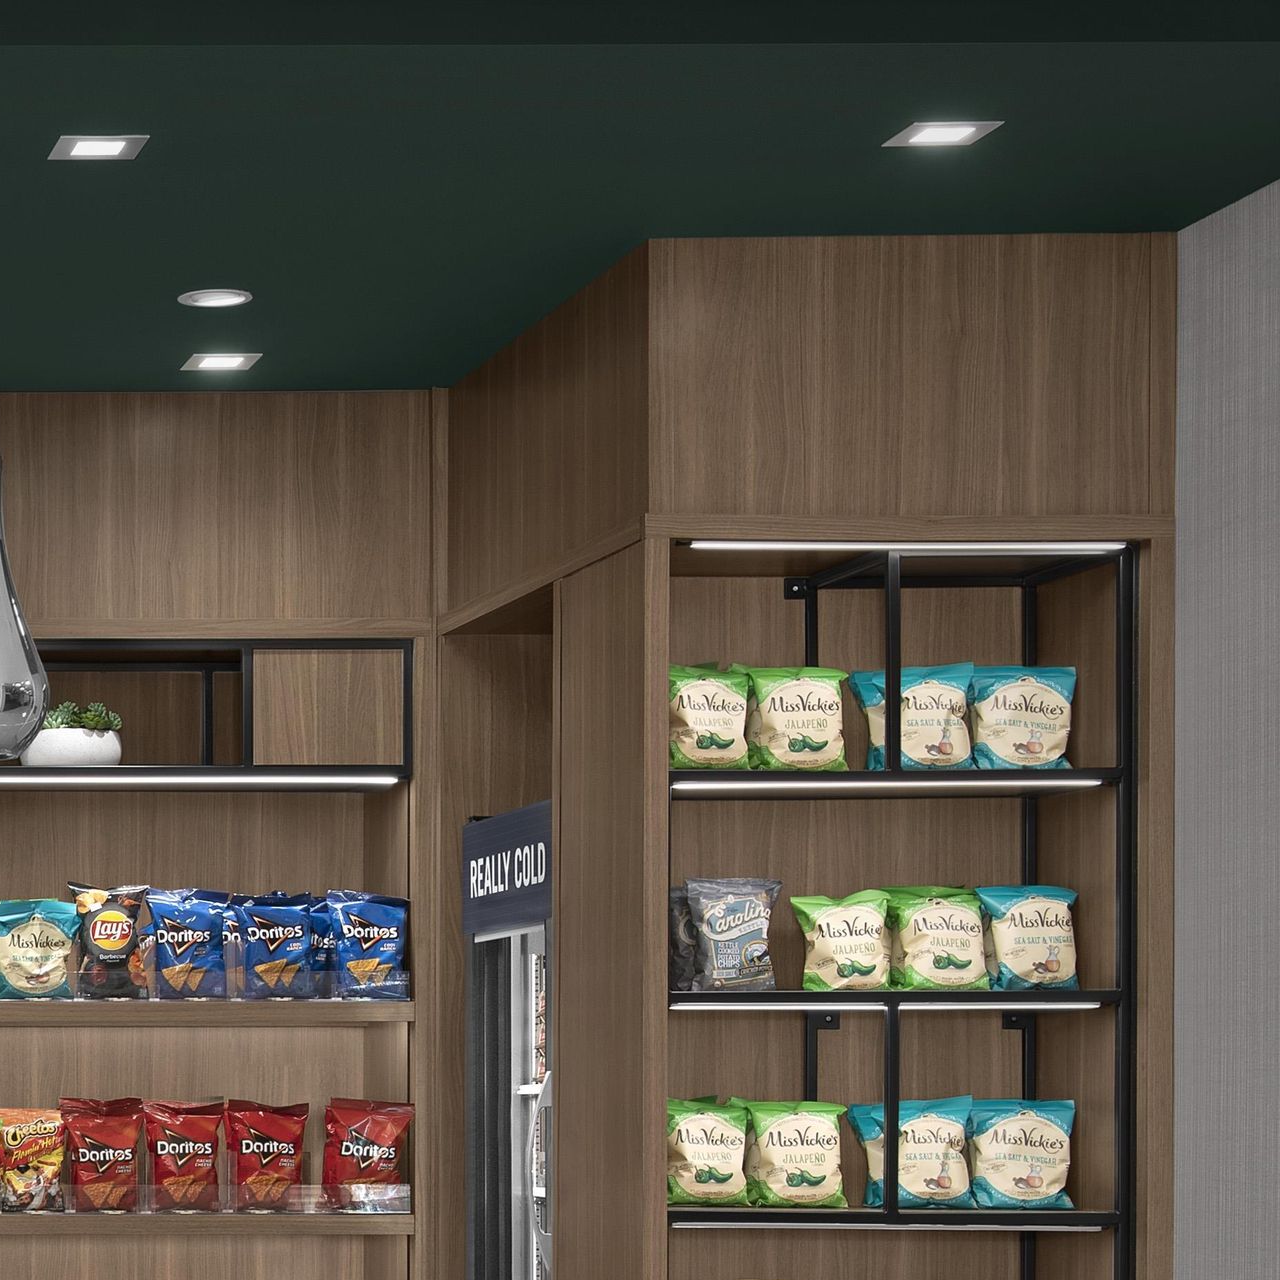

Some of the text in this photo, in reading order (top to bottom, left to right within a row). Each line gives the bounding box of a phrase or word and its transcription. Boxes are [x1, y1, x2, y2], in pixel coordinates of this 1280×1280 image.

[677, 693, 744, 716] Miss Vickie's
[768, 692, 840, 715] Miss Vickie's
[991, 693, 1064, 719] Miss Vickie's
[693, 718, 733, 727] JALAPEÑO
[785, 718, 827, 729] JALAPEÑO
[470, 842, 546, 899] REALLY COLD
[914, 914, 980, 937] Miss Vickie's
[1009, 913, 1038, 928] Miss
[94, 920, 131, 940] Lay's
[158, 929, 210, 944] Doritos
[250, 925, 303, 942] Doritos
[345, 925, 398, 940] Doritos
[816, 922, 847, 940] Miss
[9, 931, 66, 950] Miss Vickie's
[930, 937, 970, 947] JALAPEÑO
[833, 942, 875, 955] JALAPEÑO
[718, 960, 740, 968] CHIPS
[6, 1122, 57, 1148] Cheetos
[676, 1127, 744, 1150] Miss Vickie's
[766, 1126, 838, 1150] Miss Vickie's
[989, 1127, 1065, 1154] Miss Vickie's
[157, 1141, 212, 1155] Doritos
[242, 1140, 294, 1154] Doritos
[341, 1142, 396, 1158] Doritos
[79, 1148, 132, 1162] Doritos
[692, 1152, 732, 1161] JALAPEÑO
[783, 1153, 826, 1163] JALAPEÑO
[1030, 1156, 1056, 1166] VINEGAR
